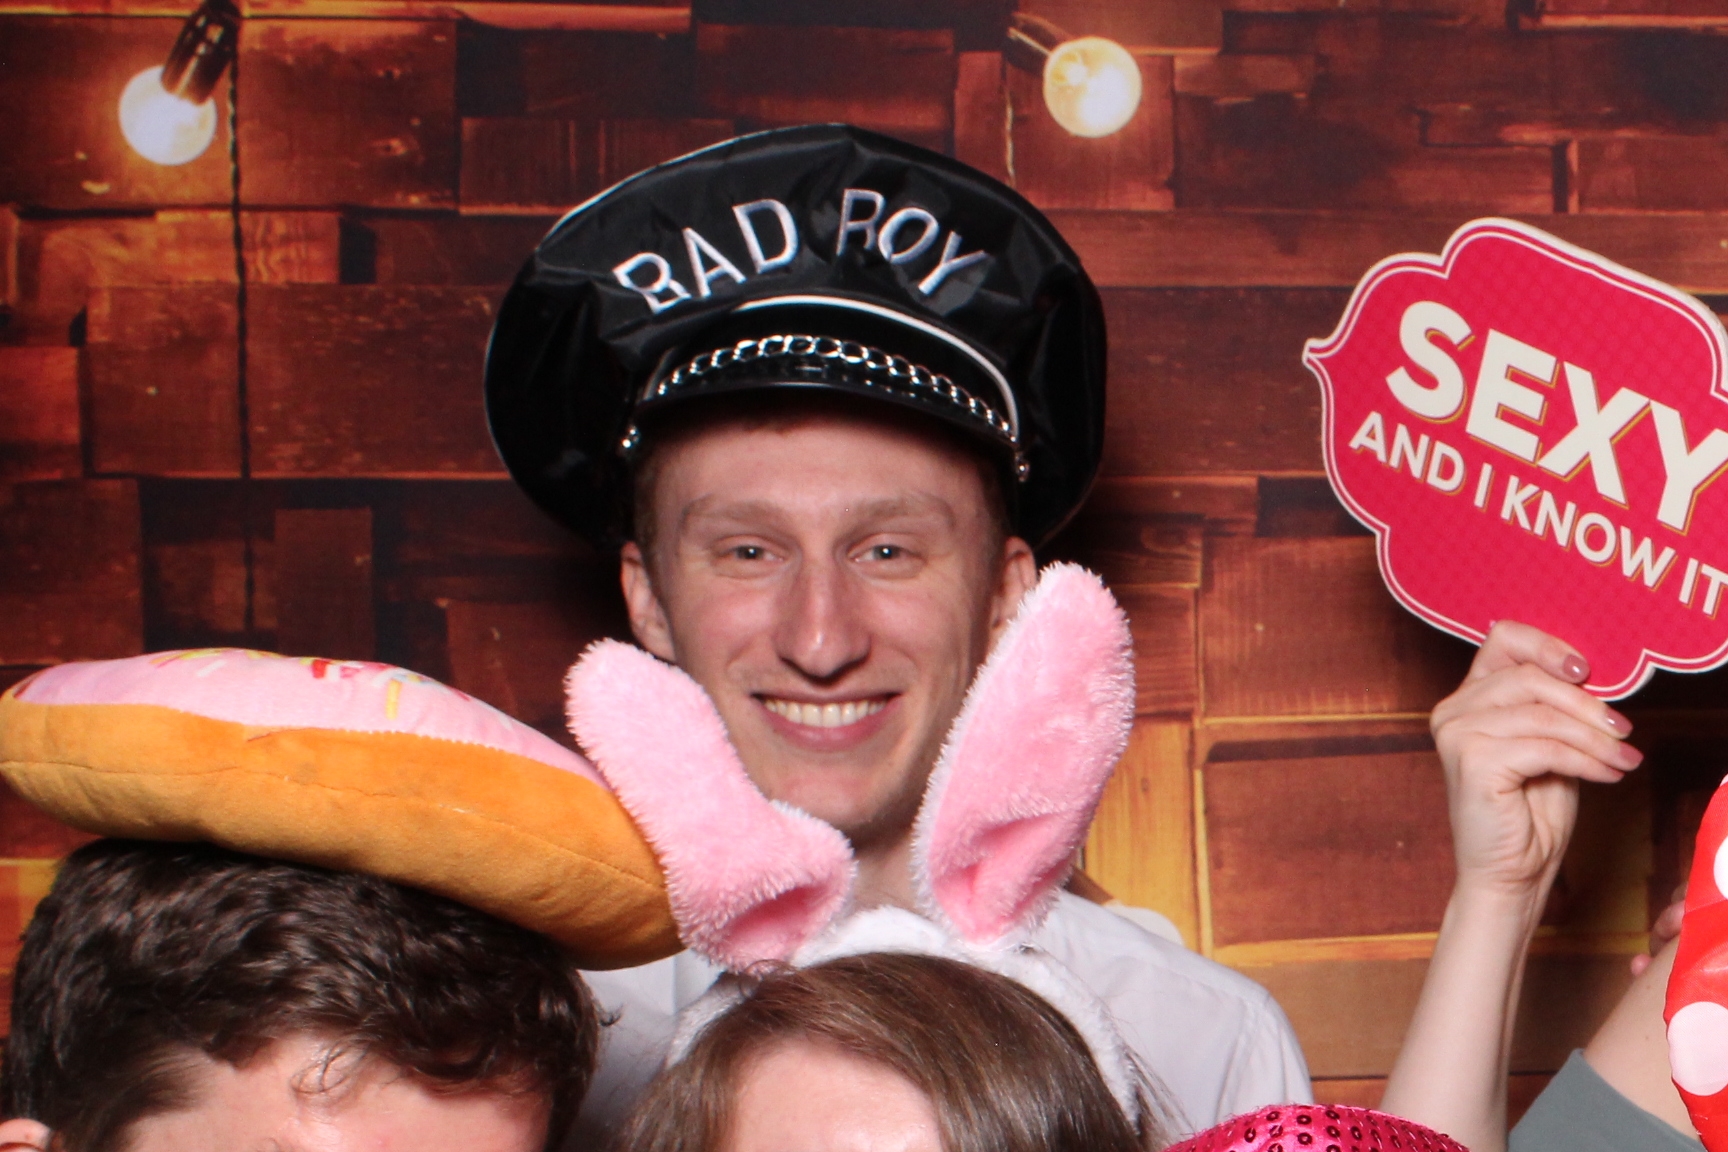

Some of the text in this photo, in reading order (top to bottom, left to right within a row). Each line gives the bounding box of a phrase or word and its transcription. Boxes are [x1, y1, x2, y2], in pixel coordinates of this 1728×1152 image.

[612, 199, 798, 314] BAD
[1349, 411, 1465, 497] AND
[1473, 463, 1494, 512] I
[1501, 476, 1676, 592] KNOW
